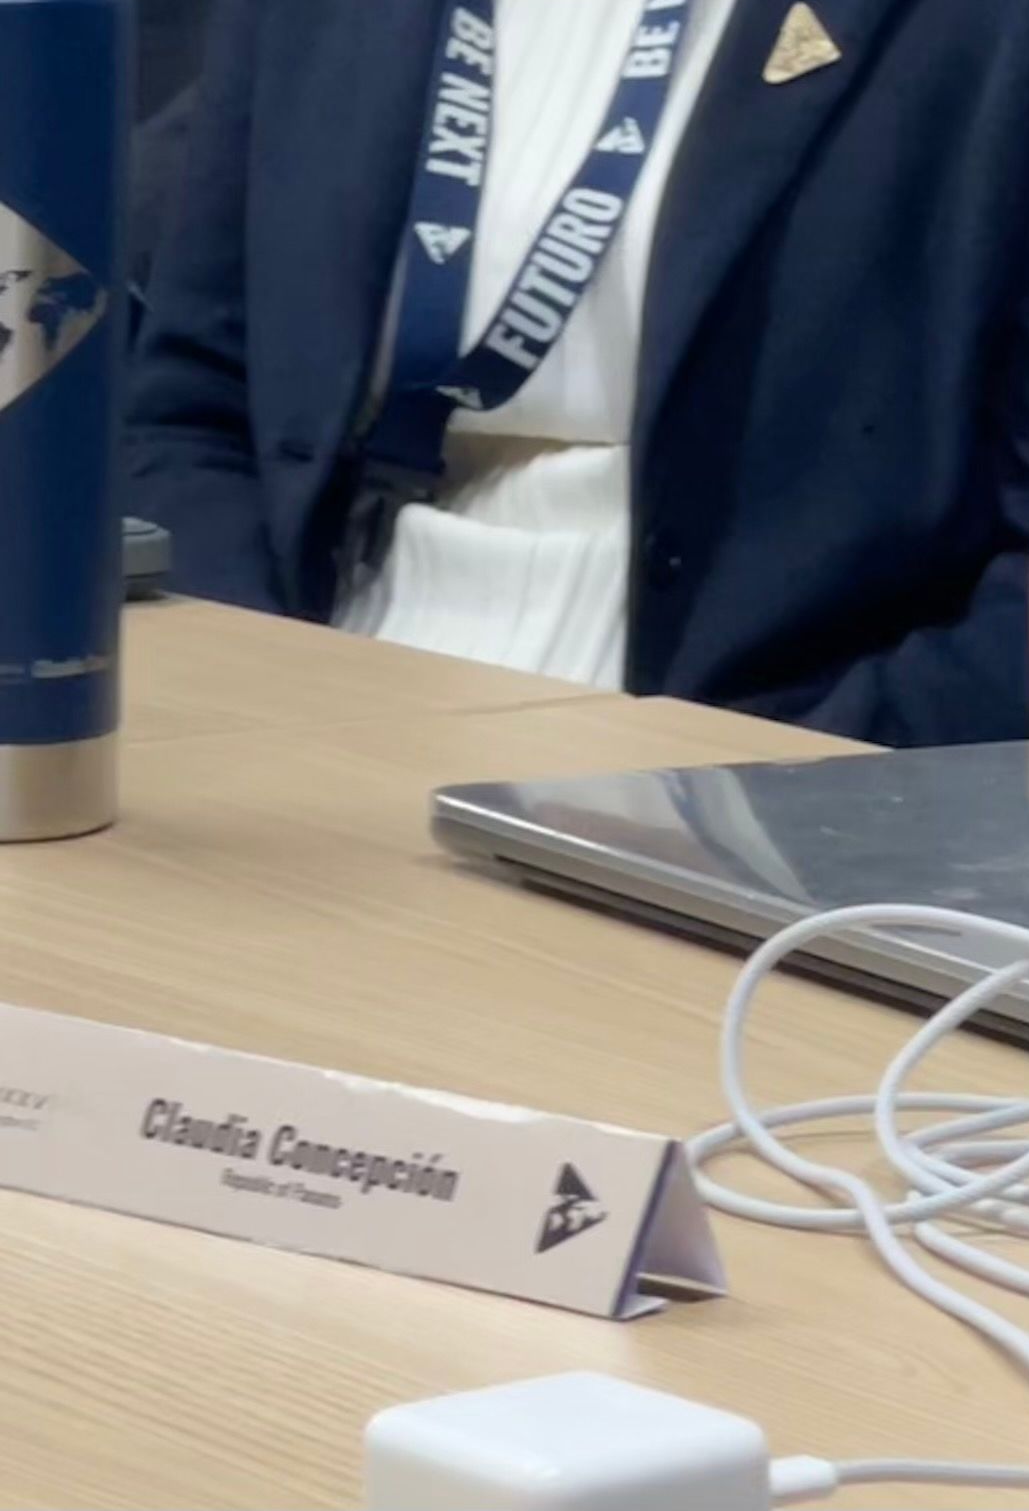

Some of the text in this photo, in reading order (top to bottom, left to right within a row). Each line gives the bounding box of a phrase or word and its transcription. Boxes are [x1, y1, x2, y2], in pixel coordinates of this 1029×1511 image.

[424, 6, 493, 187] BE NEXT
[622, 20, 681, 78] BE
[485, 188, 624, 369] FUTURO
